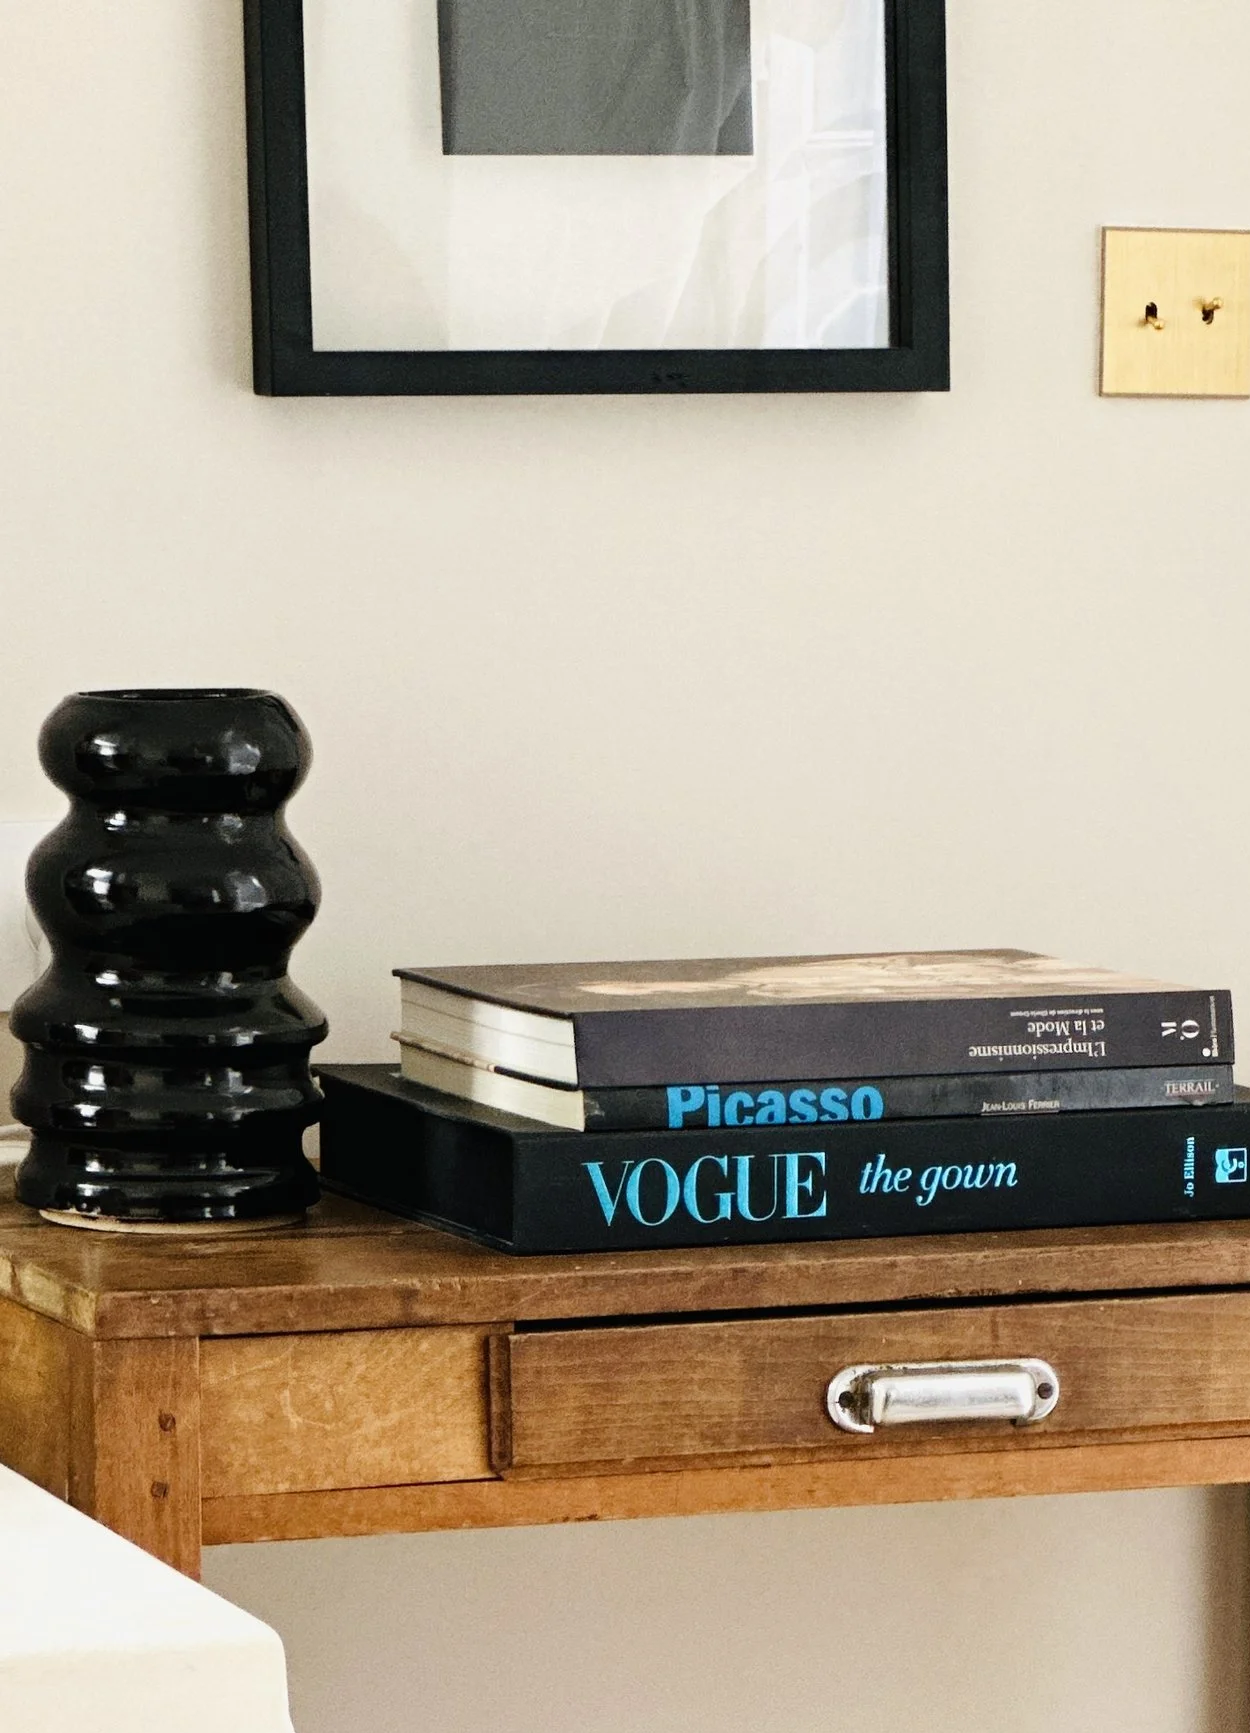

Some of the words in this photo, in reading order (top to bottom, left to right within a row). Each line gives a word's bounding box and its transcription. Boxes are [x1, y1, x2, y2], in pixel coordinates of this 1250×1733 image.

[1027, 1020, 1070, 1038] Mode
[1074, 1020, 1087, 1036] la
[1091, 1019, 1105, 1032] et
[968, 1037, 1107, 1062] L'Impressionnisme
[1165, 1080, 1216, 1095] TERRAIL
[666, 1085, 885, 1129] Picasso
[1184, 1136, 1195, 1179] Ellison
[580, 1151, 828, 1227] VOGUE
[859, 1153, 910, 1195] the
[916, 1158, 1018, 1206] gown
[1184, 1182, 1195, 1197] Jo
